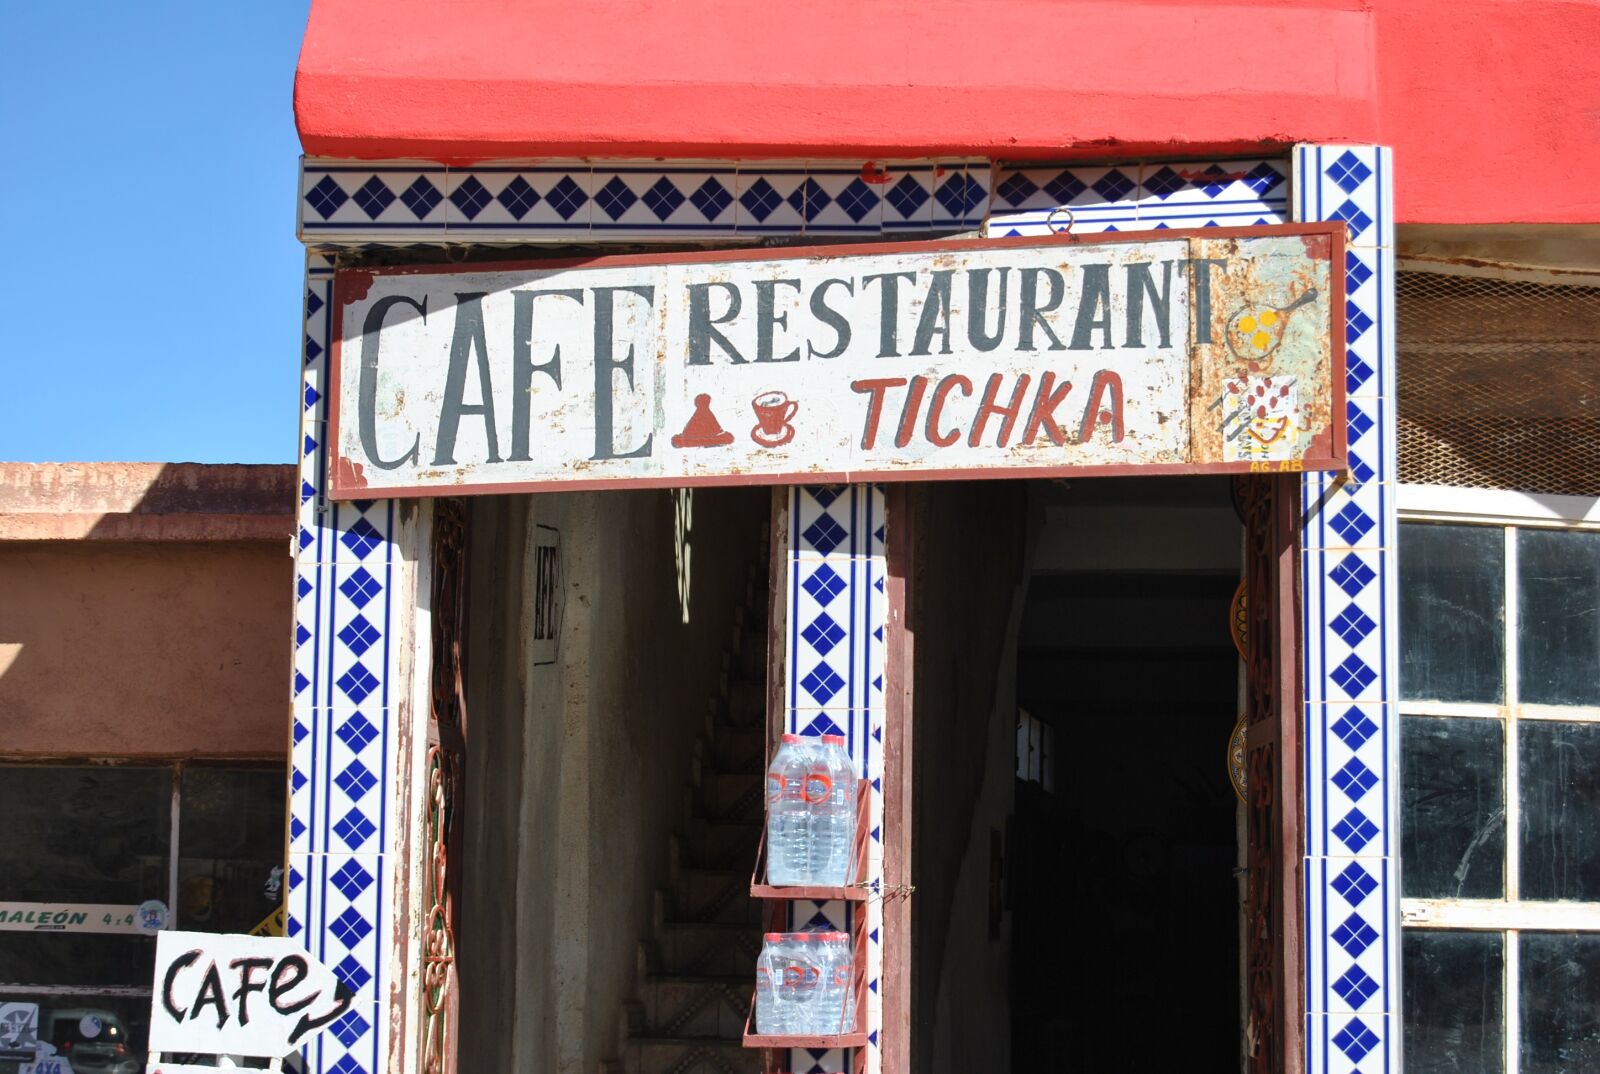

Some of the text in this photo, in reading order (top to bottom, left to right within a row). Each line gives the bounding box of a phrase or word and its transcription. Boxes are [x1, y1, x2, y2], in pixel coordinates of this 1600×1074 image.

[358, 257, 1228, 472] CAFE RESTAURANT
[850, 369, 1125, 450] TICHKA
